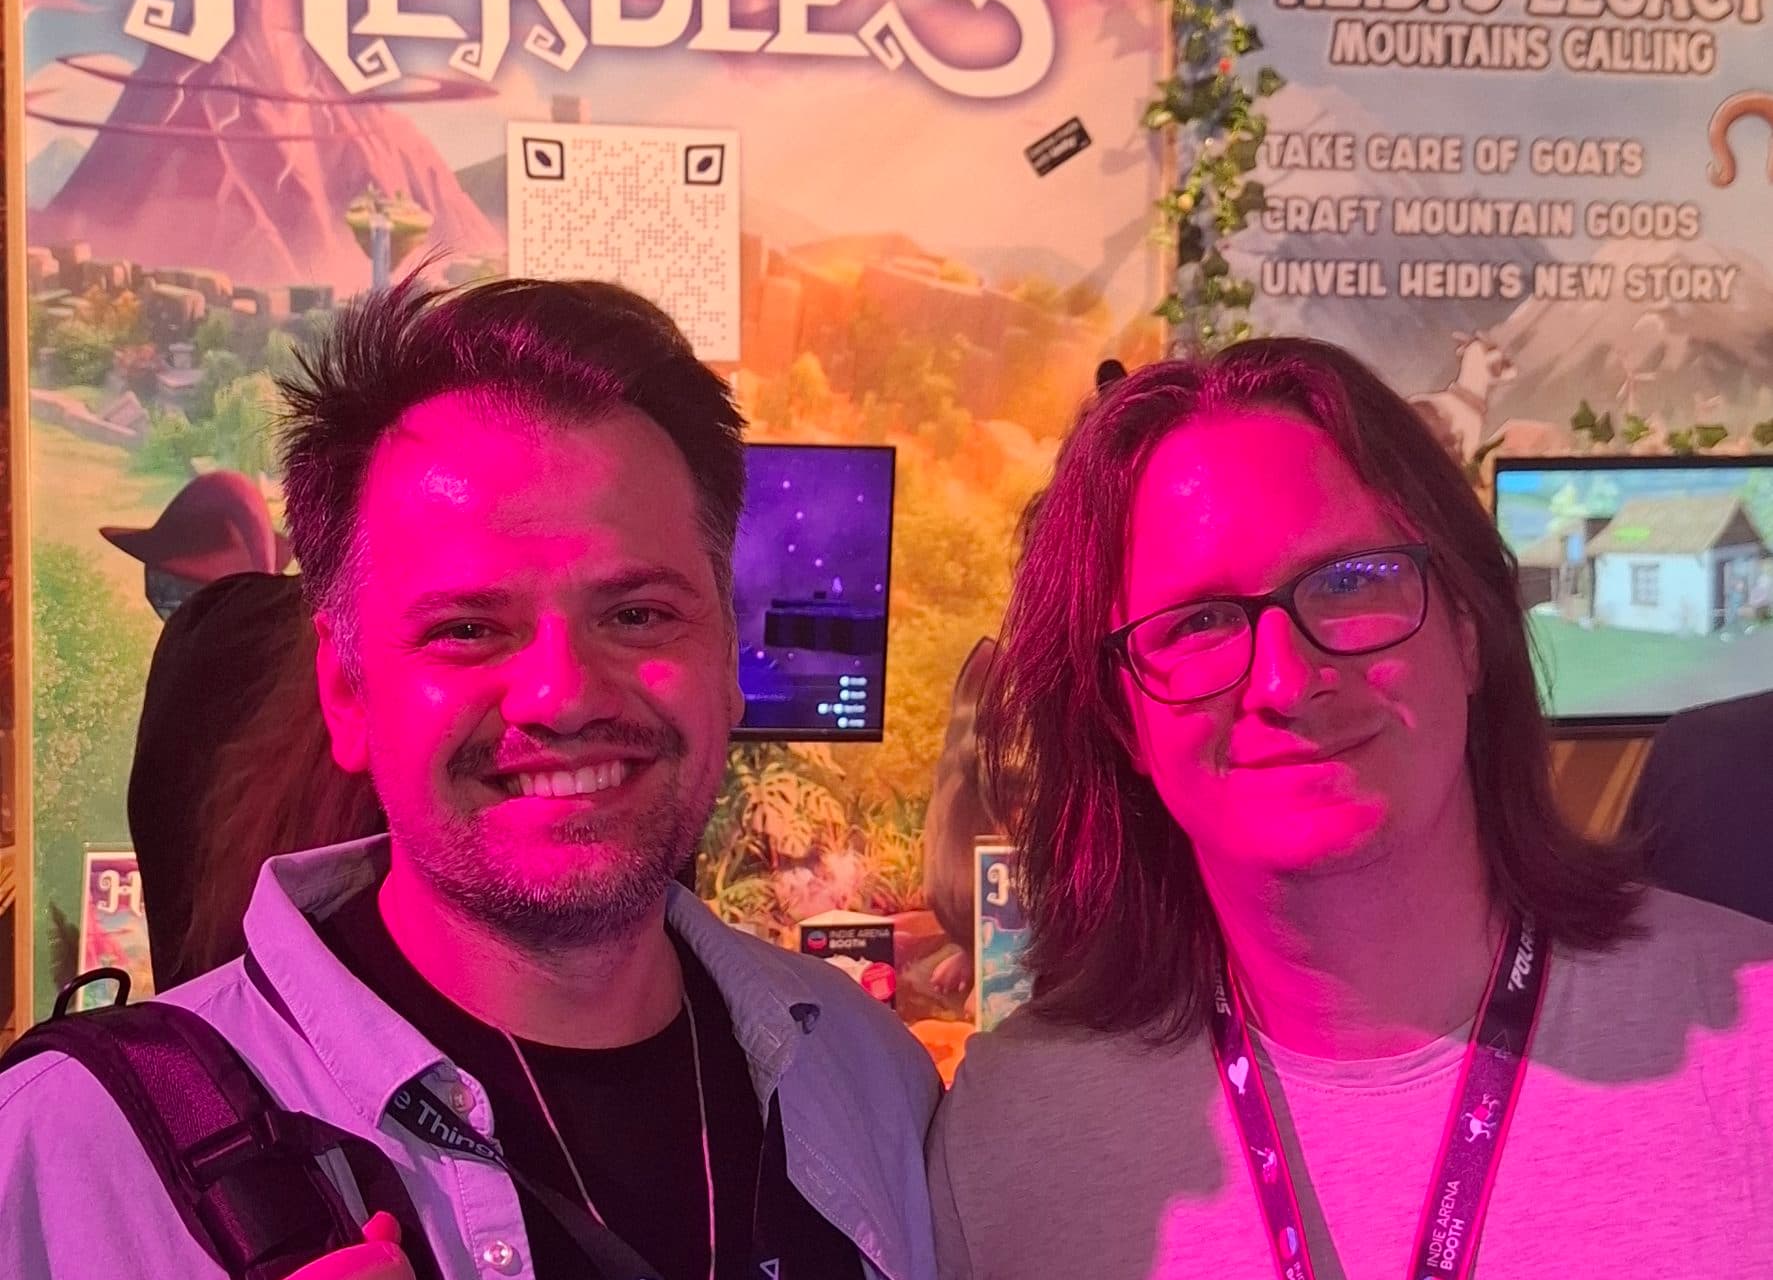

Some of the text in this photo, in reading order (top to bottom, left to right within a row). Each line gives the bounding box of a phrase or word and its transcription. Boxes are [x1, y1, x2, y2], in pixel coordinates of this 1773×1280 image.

[1331, 18, 1716, 74] MOUNTAINS CALLING
[1264, 132, 1644, 176] TAKE CARE OF GOATS
[1264, 195, 1700, 239] CRAFT MOUNTAIN GOODS
[1261, 260, 1739, 303] UNVEIL HEIDI'S NEW STORY
[828, 939, 867, 949] BOOTH
[1426, 1180, 1460, 1268] INDIE ARENA
[1440, 1218, 1465, 1271] BOOTH
